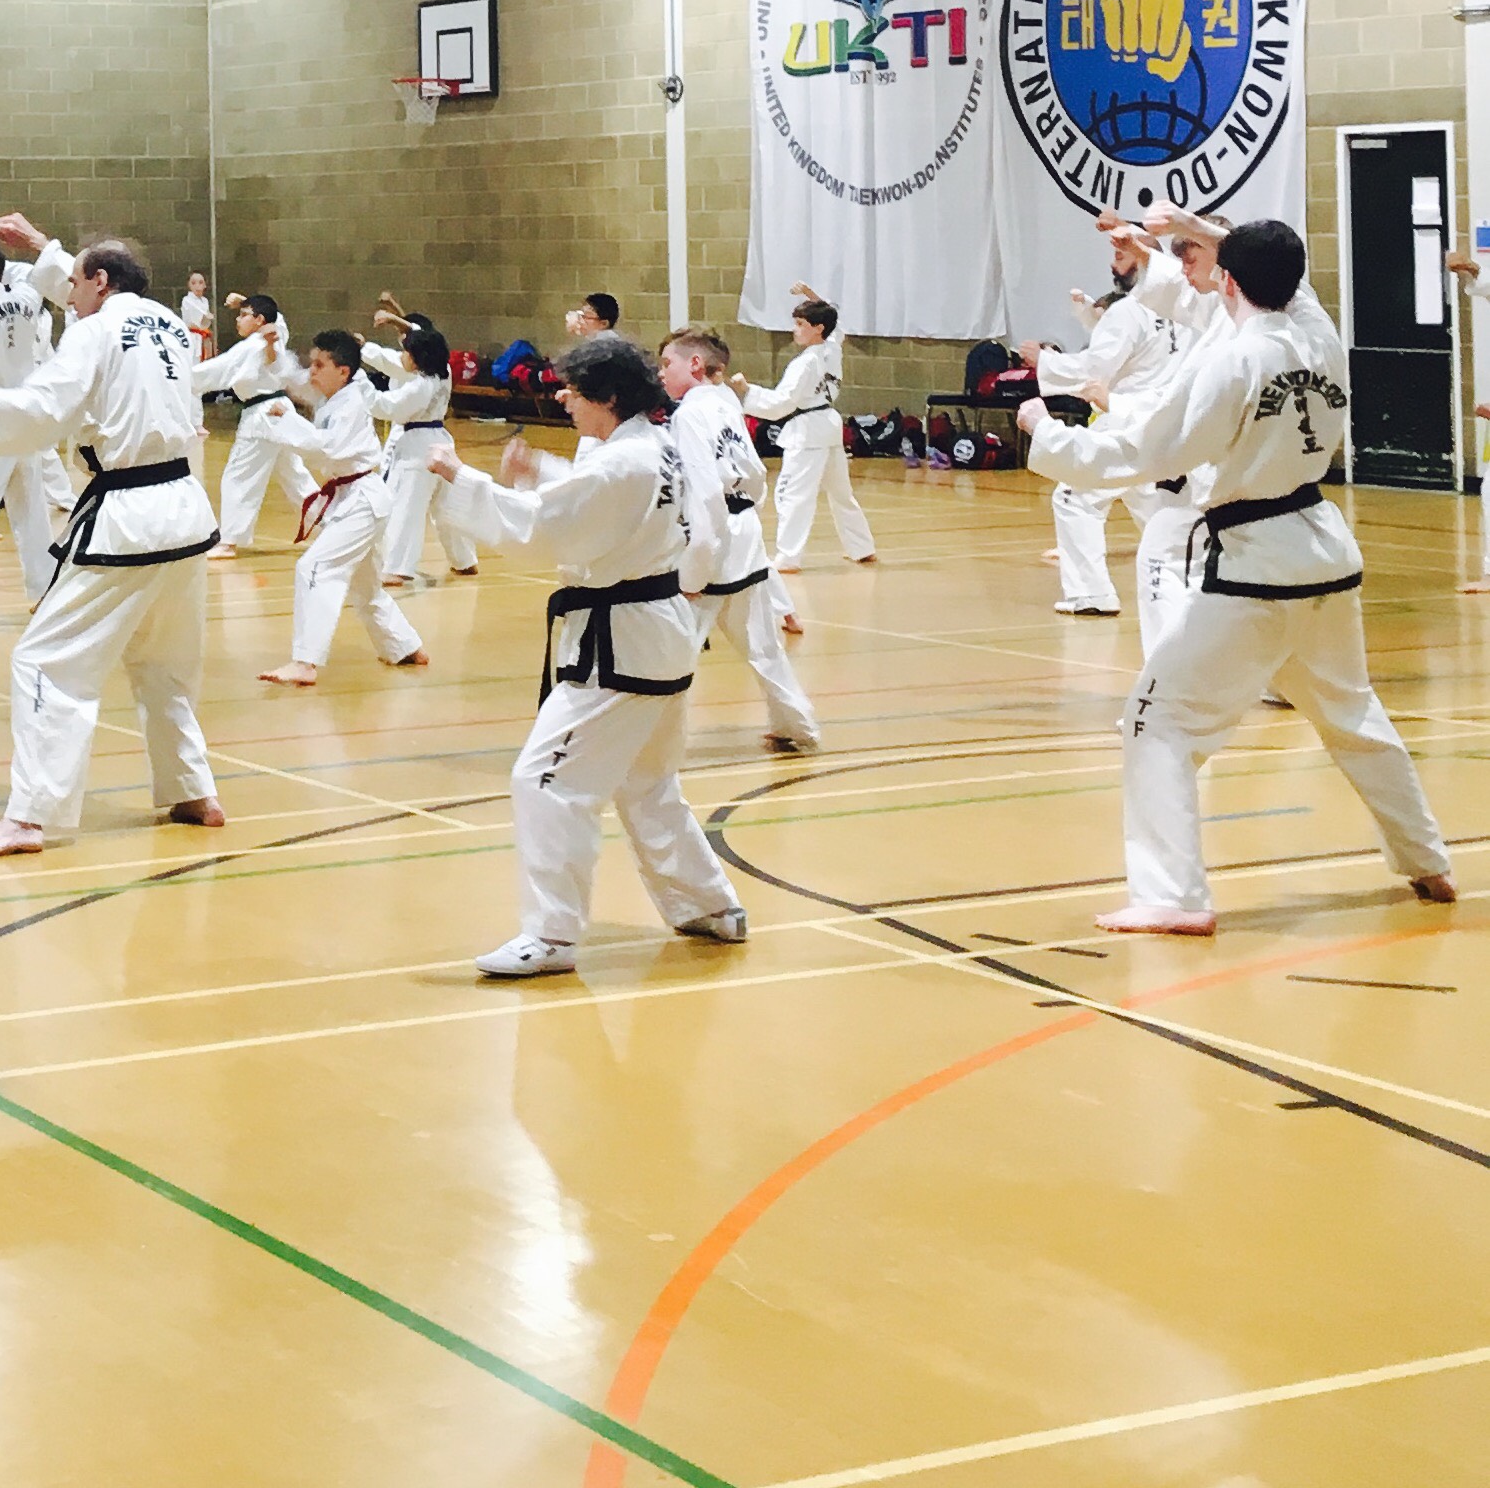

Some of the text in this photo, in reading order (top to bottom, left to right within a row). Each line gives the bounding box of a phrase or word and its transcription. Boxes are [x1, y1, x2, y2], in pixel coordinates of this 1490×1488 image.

[782, 7, 968, 76] UKTI
[787, 135, 845, 199] KINGDOM
[1134, 677, 1157, 738] ITF
[539, 730, 574, 789] ITF
